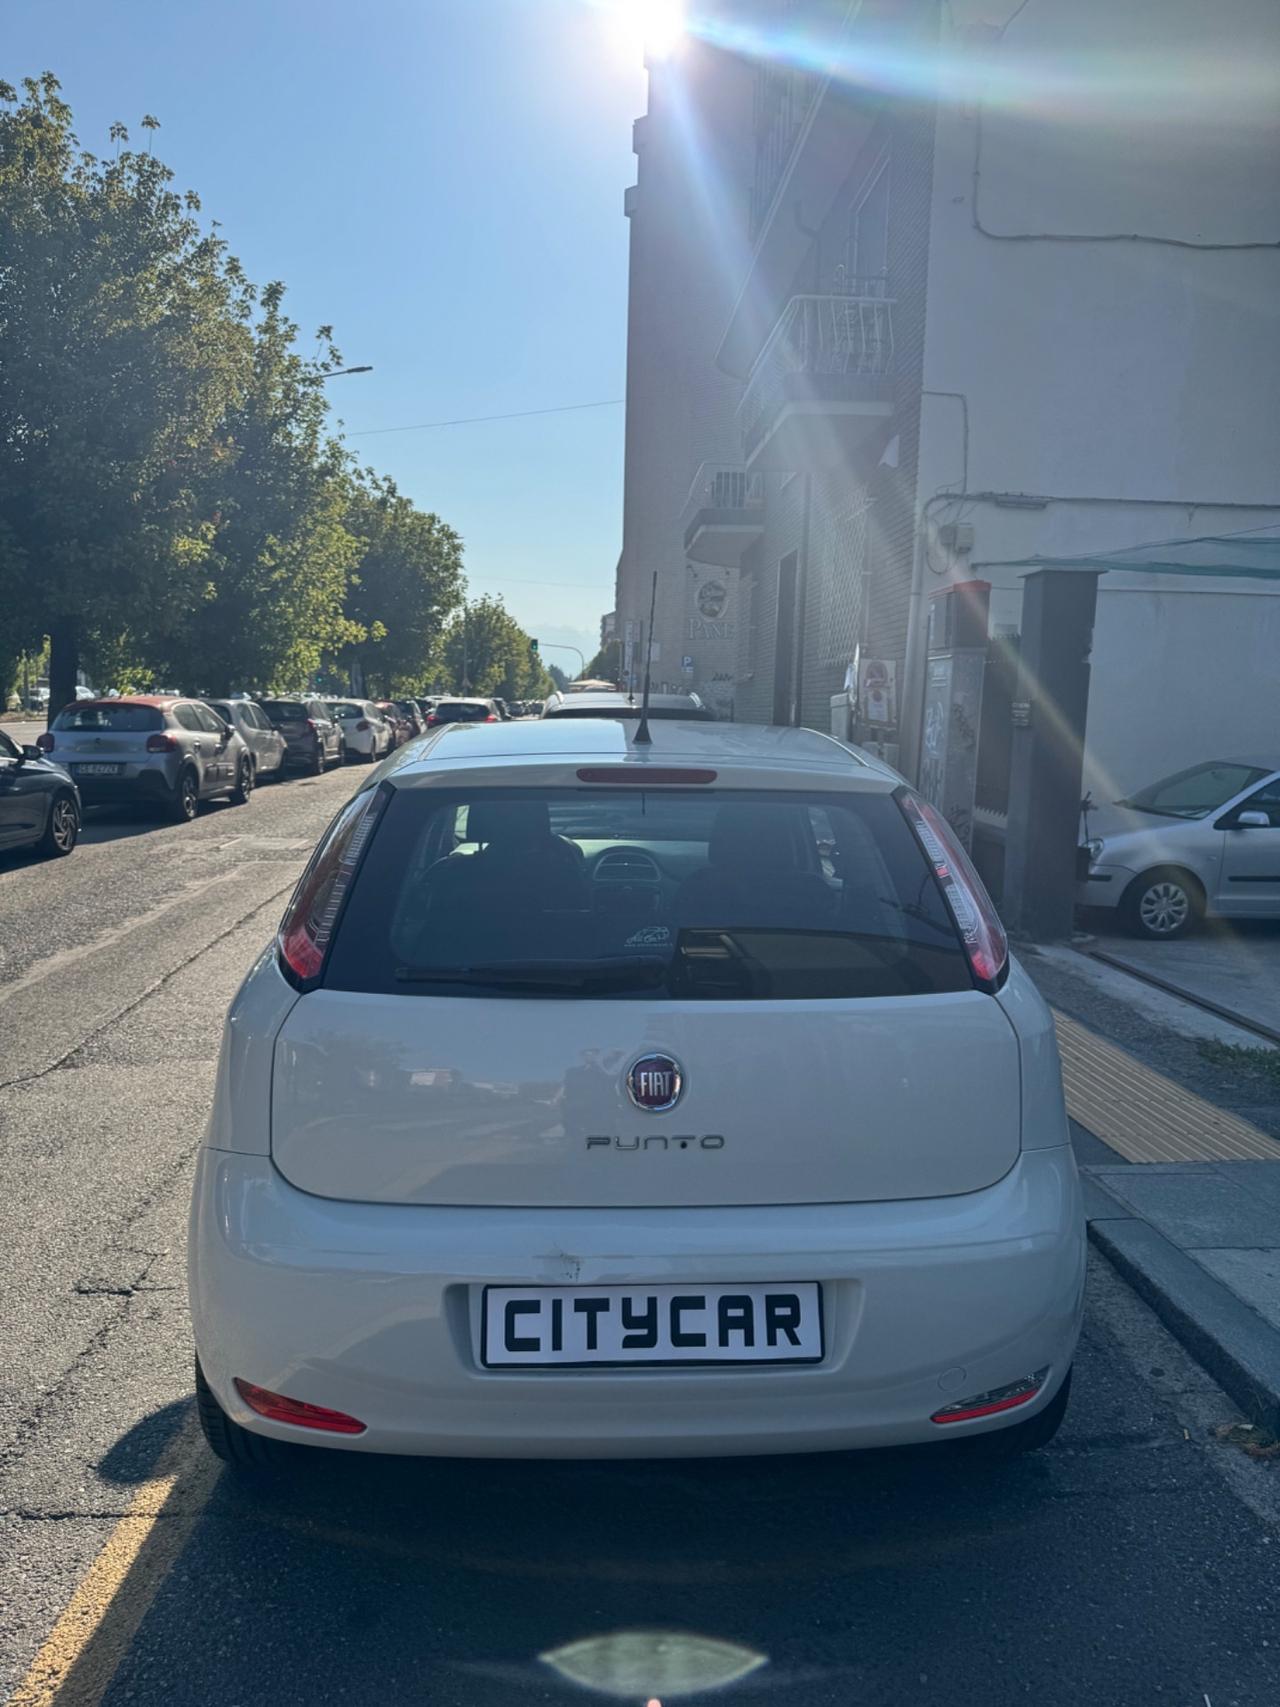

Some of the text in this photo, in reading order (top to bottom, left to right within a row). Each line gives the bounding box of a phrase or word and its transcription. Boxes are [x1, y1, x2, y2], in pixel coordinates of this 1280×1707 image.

[640, 1072, 672, 1097] FIAT
[586, 1135, 725, 1150] PUNTO
[504, 1294, 802, 1352] CITYCAR
